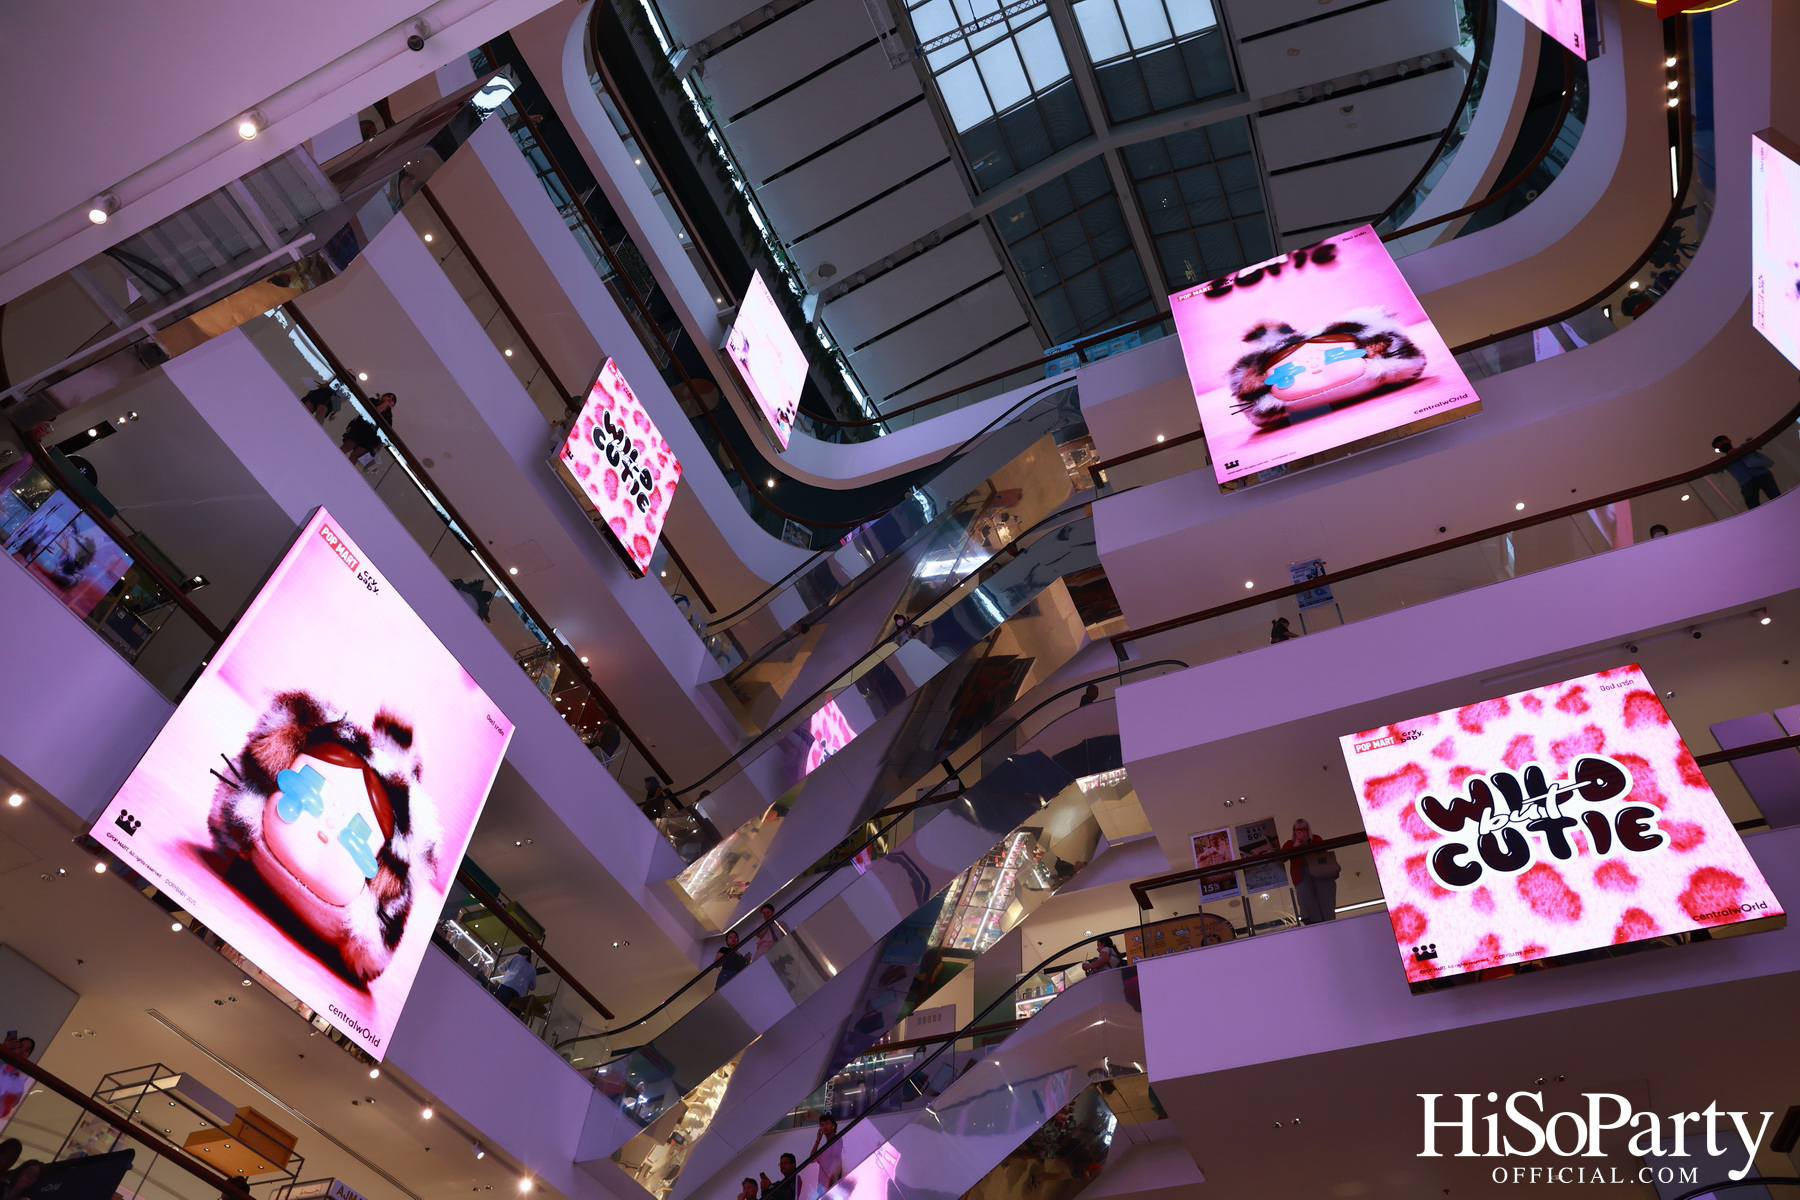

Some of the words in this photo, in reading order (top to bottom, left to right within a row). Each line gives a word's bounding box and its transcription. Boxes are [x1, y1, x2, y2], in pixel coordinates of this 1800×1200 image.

[1179, 293, 1192, 301] POP
[1193, 285, 1211, 296] MART
[593, 427, 650, 514] CUTIE
[320, 526, 338, 545] POP
[335, 543, 358, 569] MART
[363, 570, 378, 586] cry
[1355, 742, 1372, 753] POP
[1372, 737, 1395, 749] MART
[1401, 729, 1417, 737] cry
[1420, 757, 1627, 833] WILD
[1477, 781, 1593, 836] but
[1432, 806, 1664, 887] CUTIE
[1692, 901, 1768, 922] centralwOrld
[328, 1003, 381, 1048] centralwOrld
[336, 1185, 363, 1200] AJM
